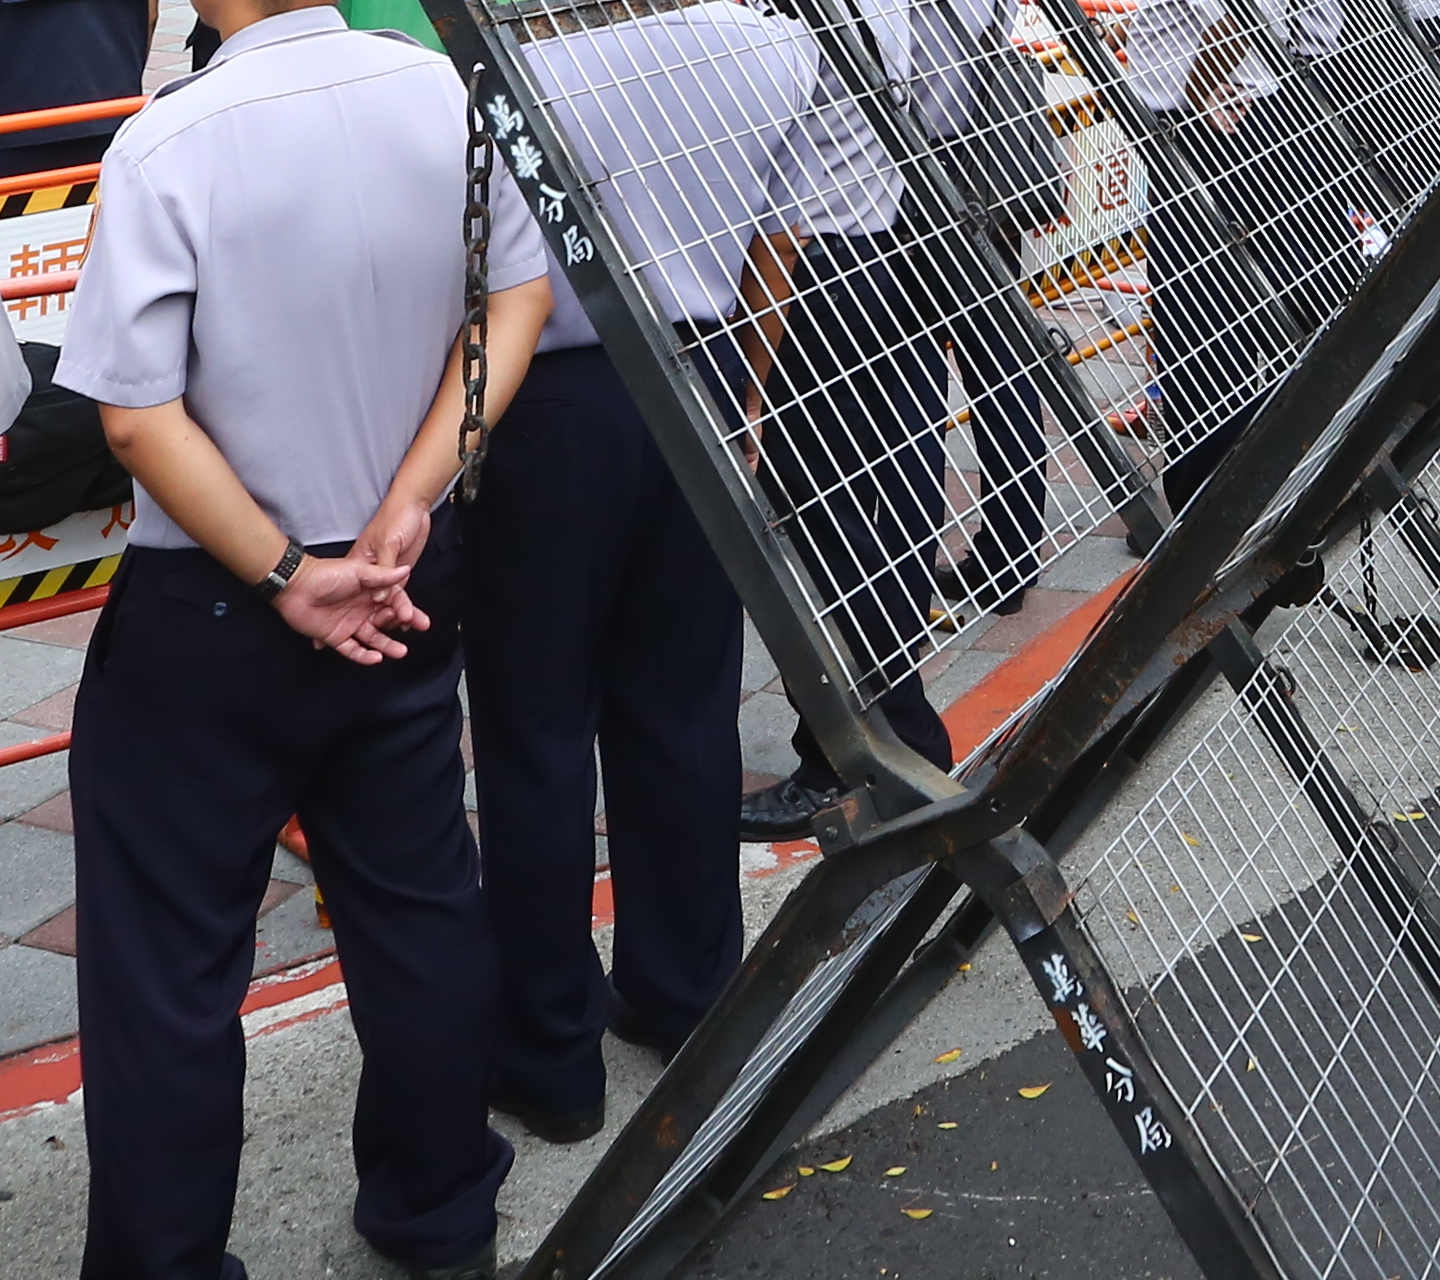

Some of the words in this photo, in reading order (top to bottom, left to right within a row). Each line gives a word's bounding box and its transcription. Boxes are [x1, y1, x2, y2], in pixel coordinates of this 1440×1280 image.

[486, 93, 594, 267] 萬華分局
[1041, 952, 1172, 1156] 萬華分局
